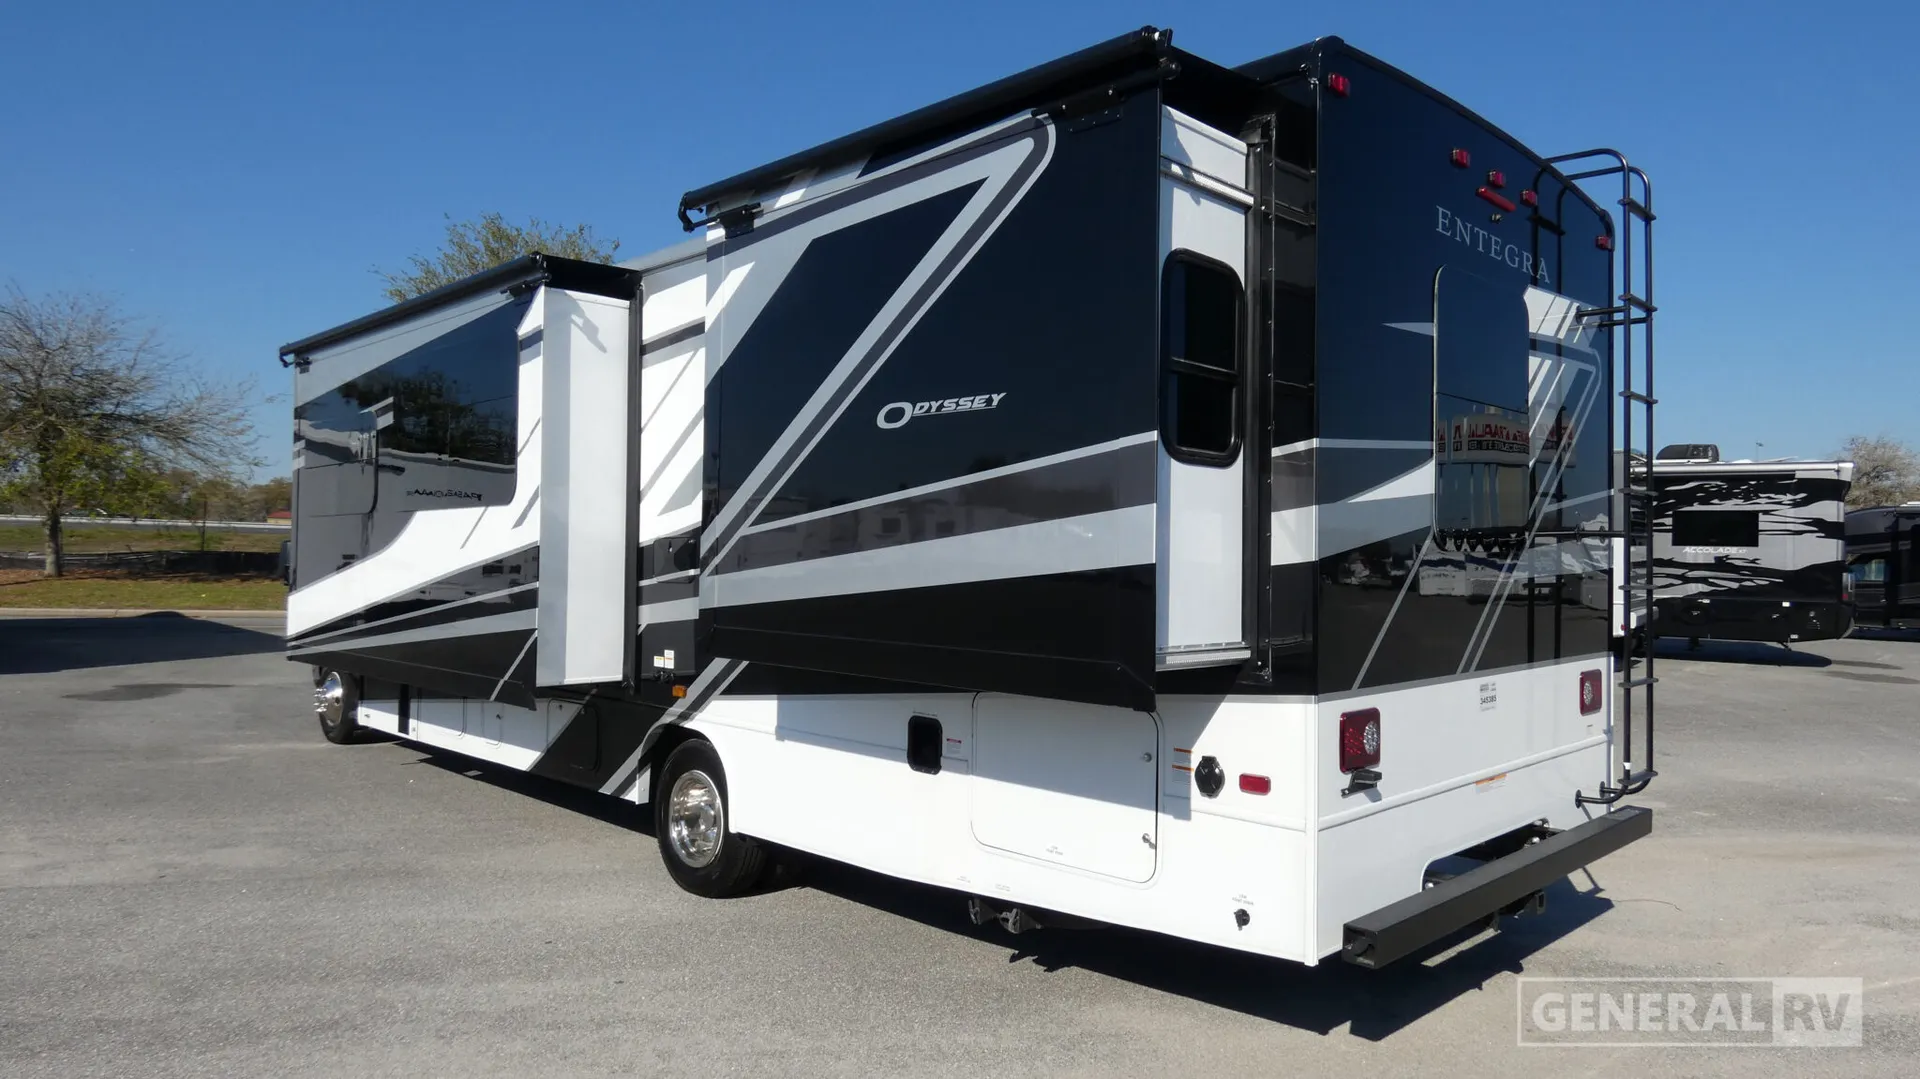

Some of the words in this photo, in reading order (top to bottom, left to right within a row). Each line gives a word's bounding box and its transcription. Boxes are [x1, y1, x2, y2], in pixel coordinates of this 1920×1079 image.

[1436, 205, 1550, 284] ENTEGRA
[876, 392, 1007, 429] ODYSSEY
[1682, 546, 1738, 554] ACCOLADE
